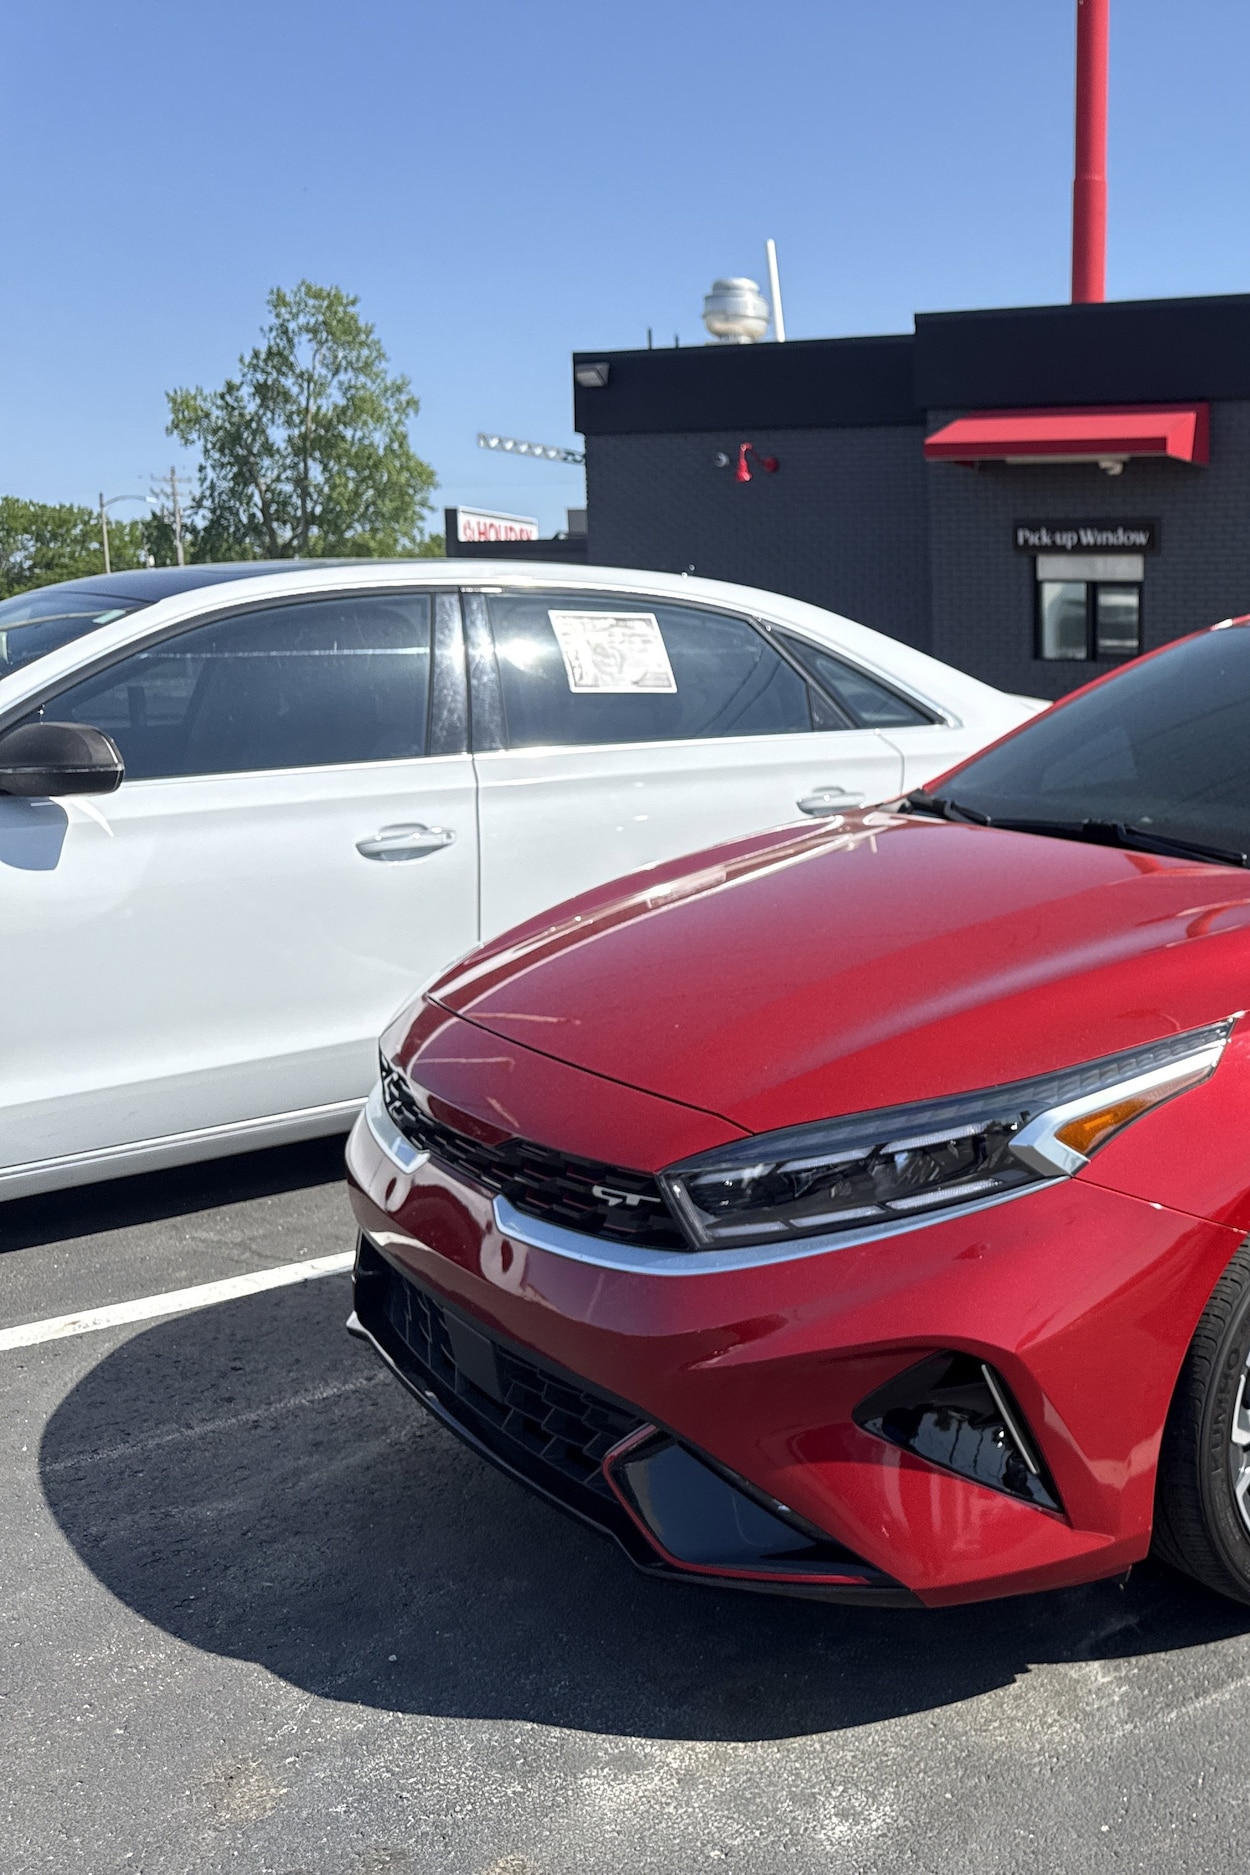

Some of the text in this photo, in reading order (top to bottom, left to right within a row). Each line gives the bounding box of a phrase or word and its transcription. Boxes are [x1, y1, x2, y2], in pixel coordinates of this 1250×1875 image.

[1079, 526, 1149, 546] Window
[592, 1185, 661, 1206] GT
[1211, 1348, 1240, 1474] KUMHO
